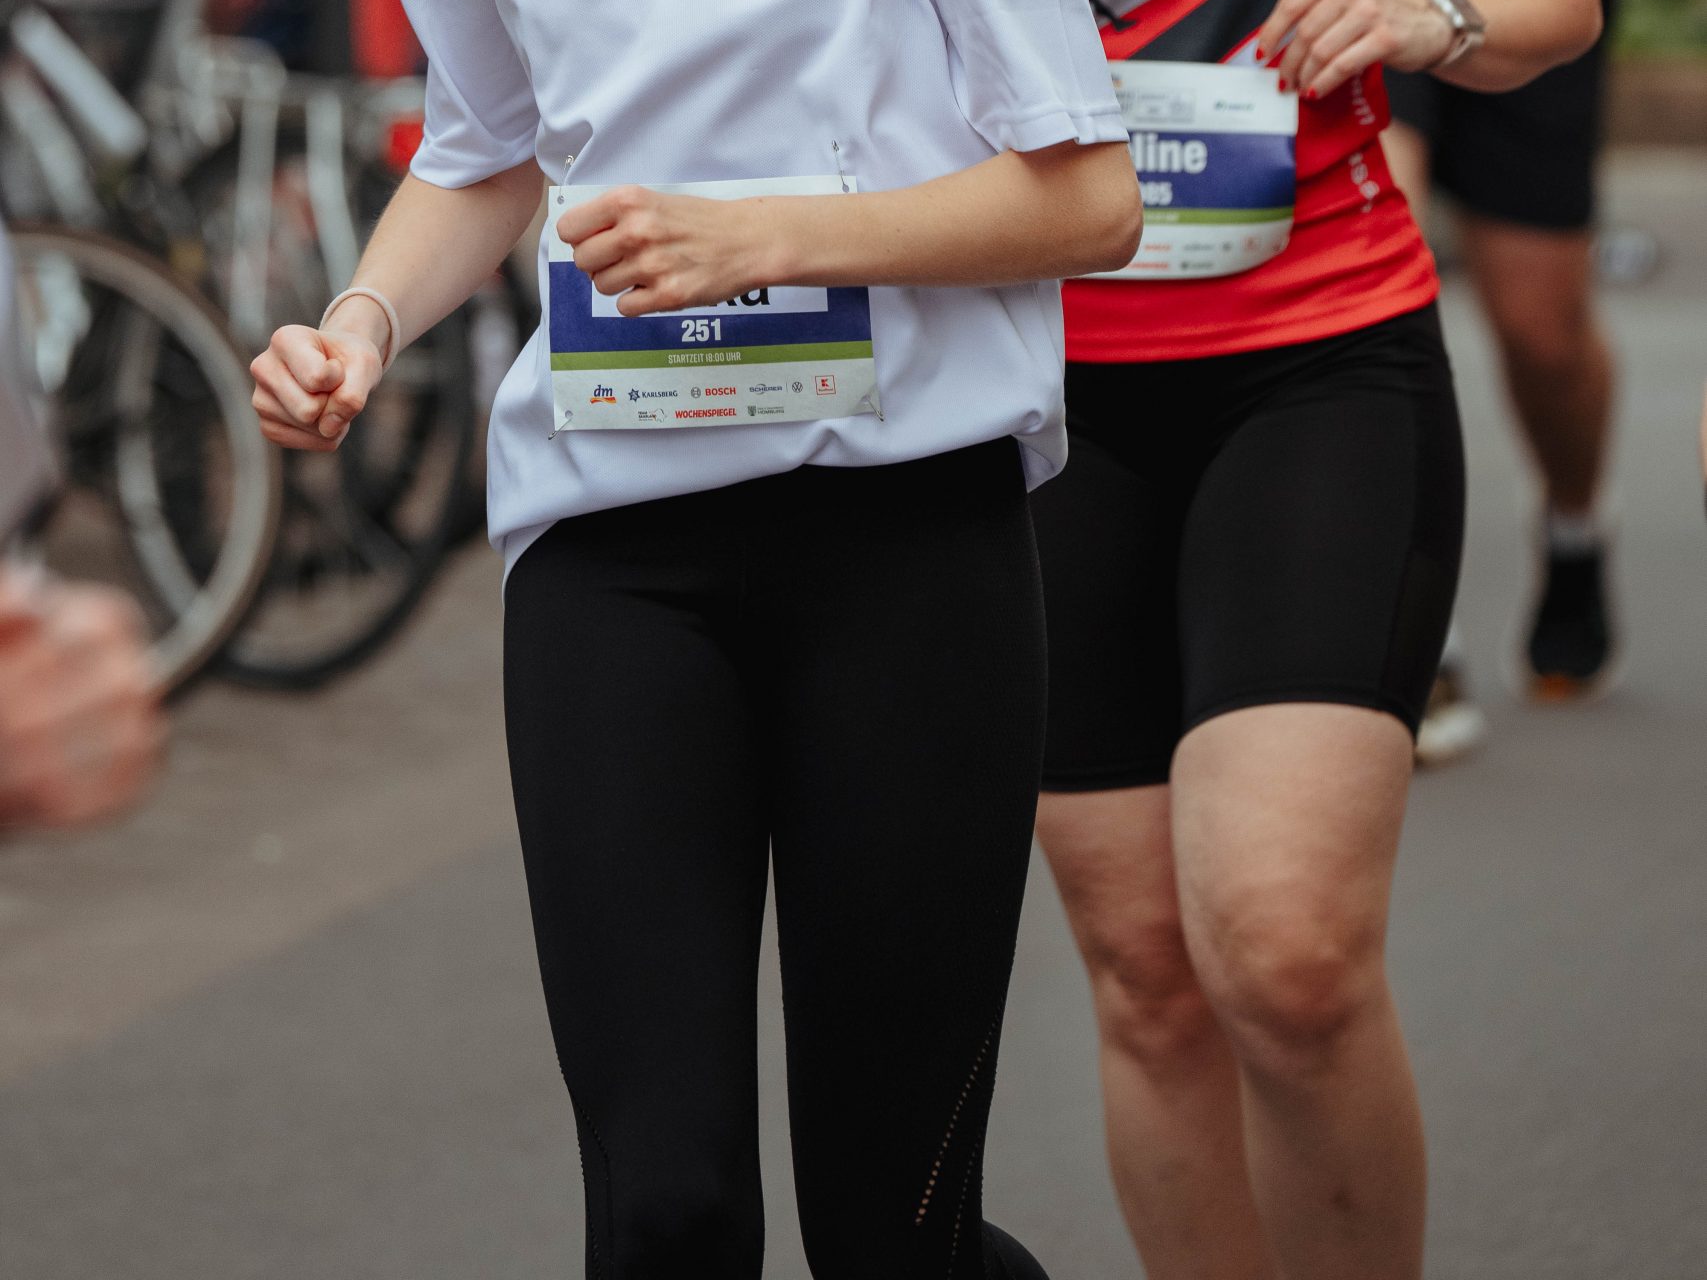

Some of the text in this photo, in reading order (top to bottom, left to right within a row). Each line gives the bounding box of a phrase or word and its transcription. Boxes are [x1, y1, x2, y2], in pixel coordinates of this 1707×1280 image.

[1131, 132, 1208, 174] line
[681, 318, 722, 343] 251
[668, 353, 704, 364] STARTZEIT
[726, 351, 742, 362] UHR
[593, 384, 613, 397] dm
[642, 389, 678, 399] KARLSBERG
[705, 387, 736, 397] BOSCH
[675, 407, 737, 419] WOCHENSPIEGEL
